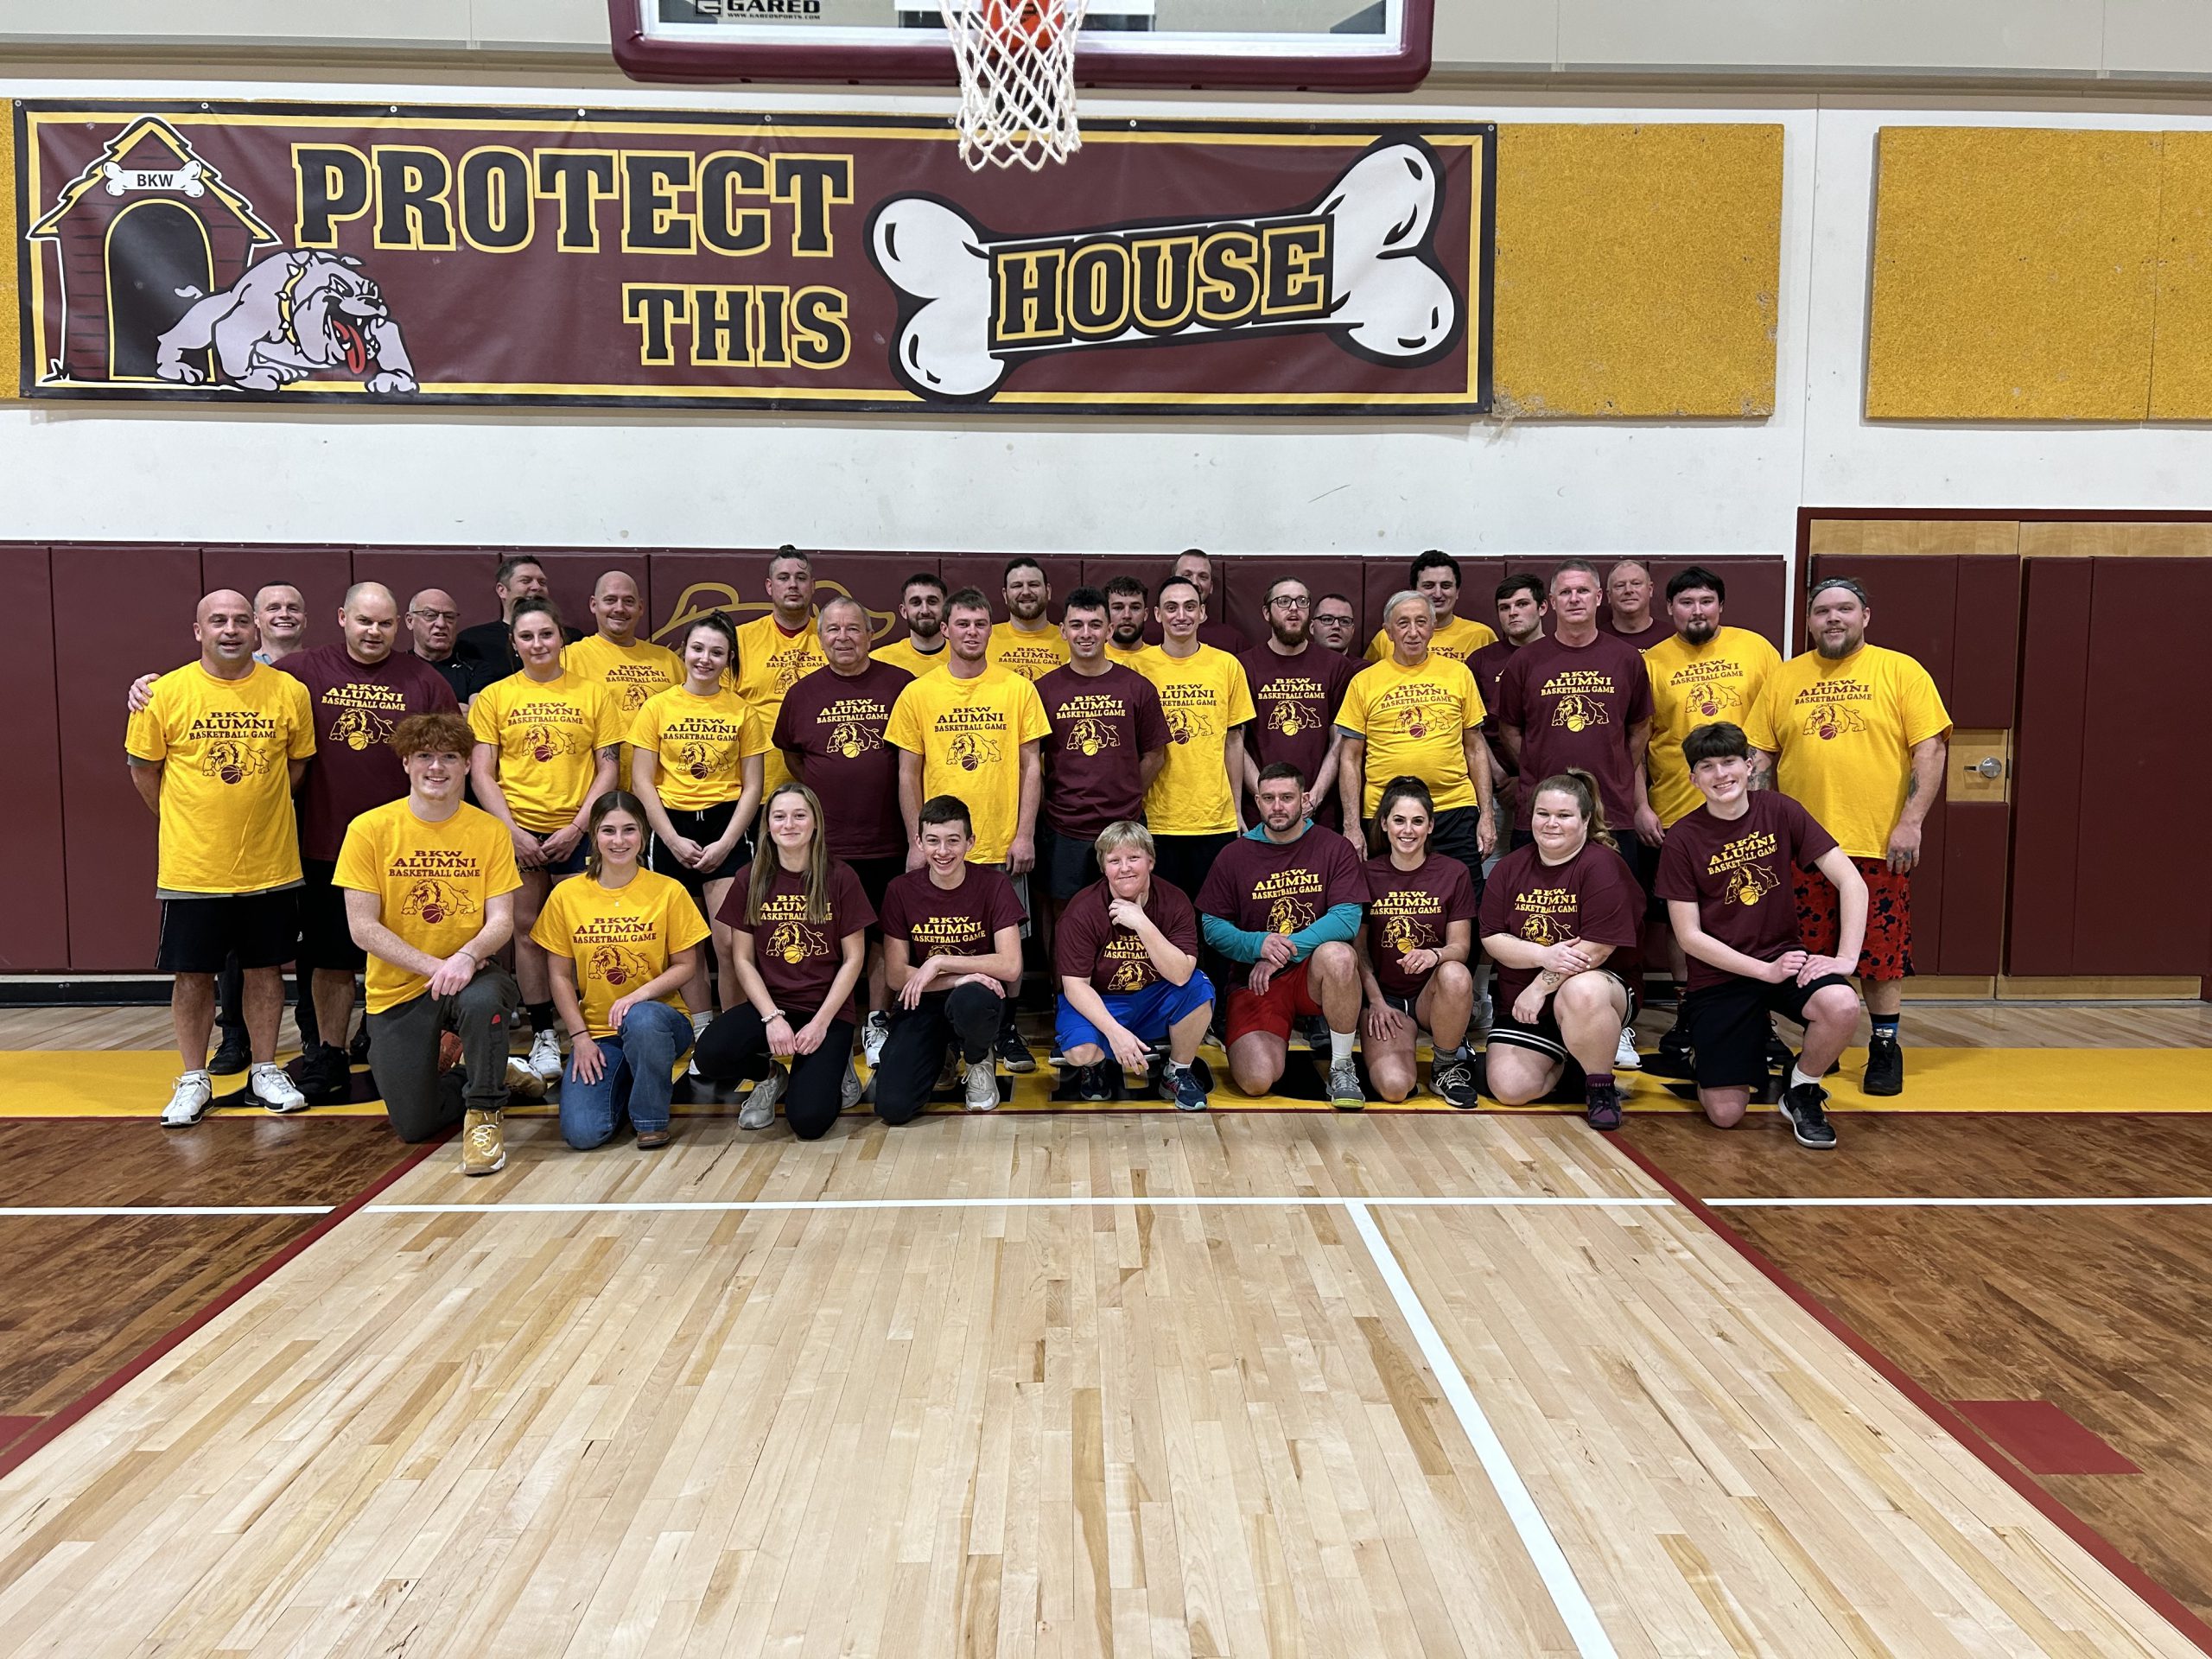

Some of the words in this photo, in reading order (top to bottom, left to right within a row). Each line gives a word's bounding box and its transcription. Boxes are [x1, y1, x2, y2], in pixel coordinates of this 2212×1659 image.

[727, 0, 820, 13] GARED
[137, 174, 174, 188] BKW
[291, 141, 855, 258] PROTECT
[996, 222, 1327, 342] HOUSE
[621, 282, 852, 370] THIS
[1688, 659, 1726, 669] BKW
[1672, 662, 1738, 678] ALUMNI
[1543, 677, 1611, 688] ALUMNI
[1670, 674, 1719, 686] BASKETBALL
[1720, 671, 1743, 679] GAME
[1260, 683, 1322, 692] ALUMNI
[1541, 687, 1590, 696] BASKETBALL
[1798, 685, 1869, 696] ALUMNI
[326, 688, 404, 702] ALUMNI
[1384, 690, 1447, 701] ALUMNI
[1795, 695, 1845, 705] BASKETBALL
[321, 696, 377, 709] BASKETBALL
[379, 702, 405, 711] GAME
[1058, 700, 1122, 710] ALUMNI
[1381, 696, 1429, 709] BASKETBALL
[510, 709, 581, 717] ALUMNI
[819, 704, 885, 716] ALUMNI
[1056, 709, 1103, 719] BASKETBALL
[1103, 709, 1125, 717] GAME
[192, 719, 274, 729] ALUMNI
[508, 716, 560, 725] BASKETBALL
[817, 714, 864, 724] BASKETBALL
[937, 714, 1003, 723] ALUMNI
[666, 724, 737, 733] ALUMNI
[189, 731, 248, 740] BASKETBALL
[393, 858, 476, 868] ALUMNI
[1707, 851, 1758, 874] BASKETALL
[1270, 869, 1306, 880] BKW
[1254, 874, 1319, 891] ALUMNI
[1252, 887, 1298, 899] BASKETBALL
[1299, 885, 1322, 893] GAME
[1372, 898, 1440, 906] ALUMNI
[1516, 893, 1576, 906] ALUMNI
[760, 902, 831, 912] ALUMI
[1515, 903, 1556, 913] ASKETBALL
[575, 922, 653, 934] ALUMNI
[912, 921, 982, 934] ALUMNI
[573, 935, 628, 944] BASKETBALL
[631, 932, 657, 943] GAME
[912, 935, 961, 944] ASKETBALL
[963, 931, 985, 942] GAME
